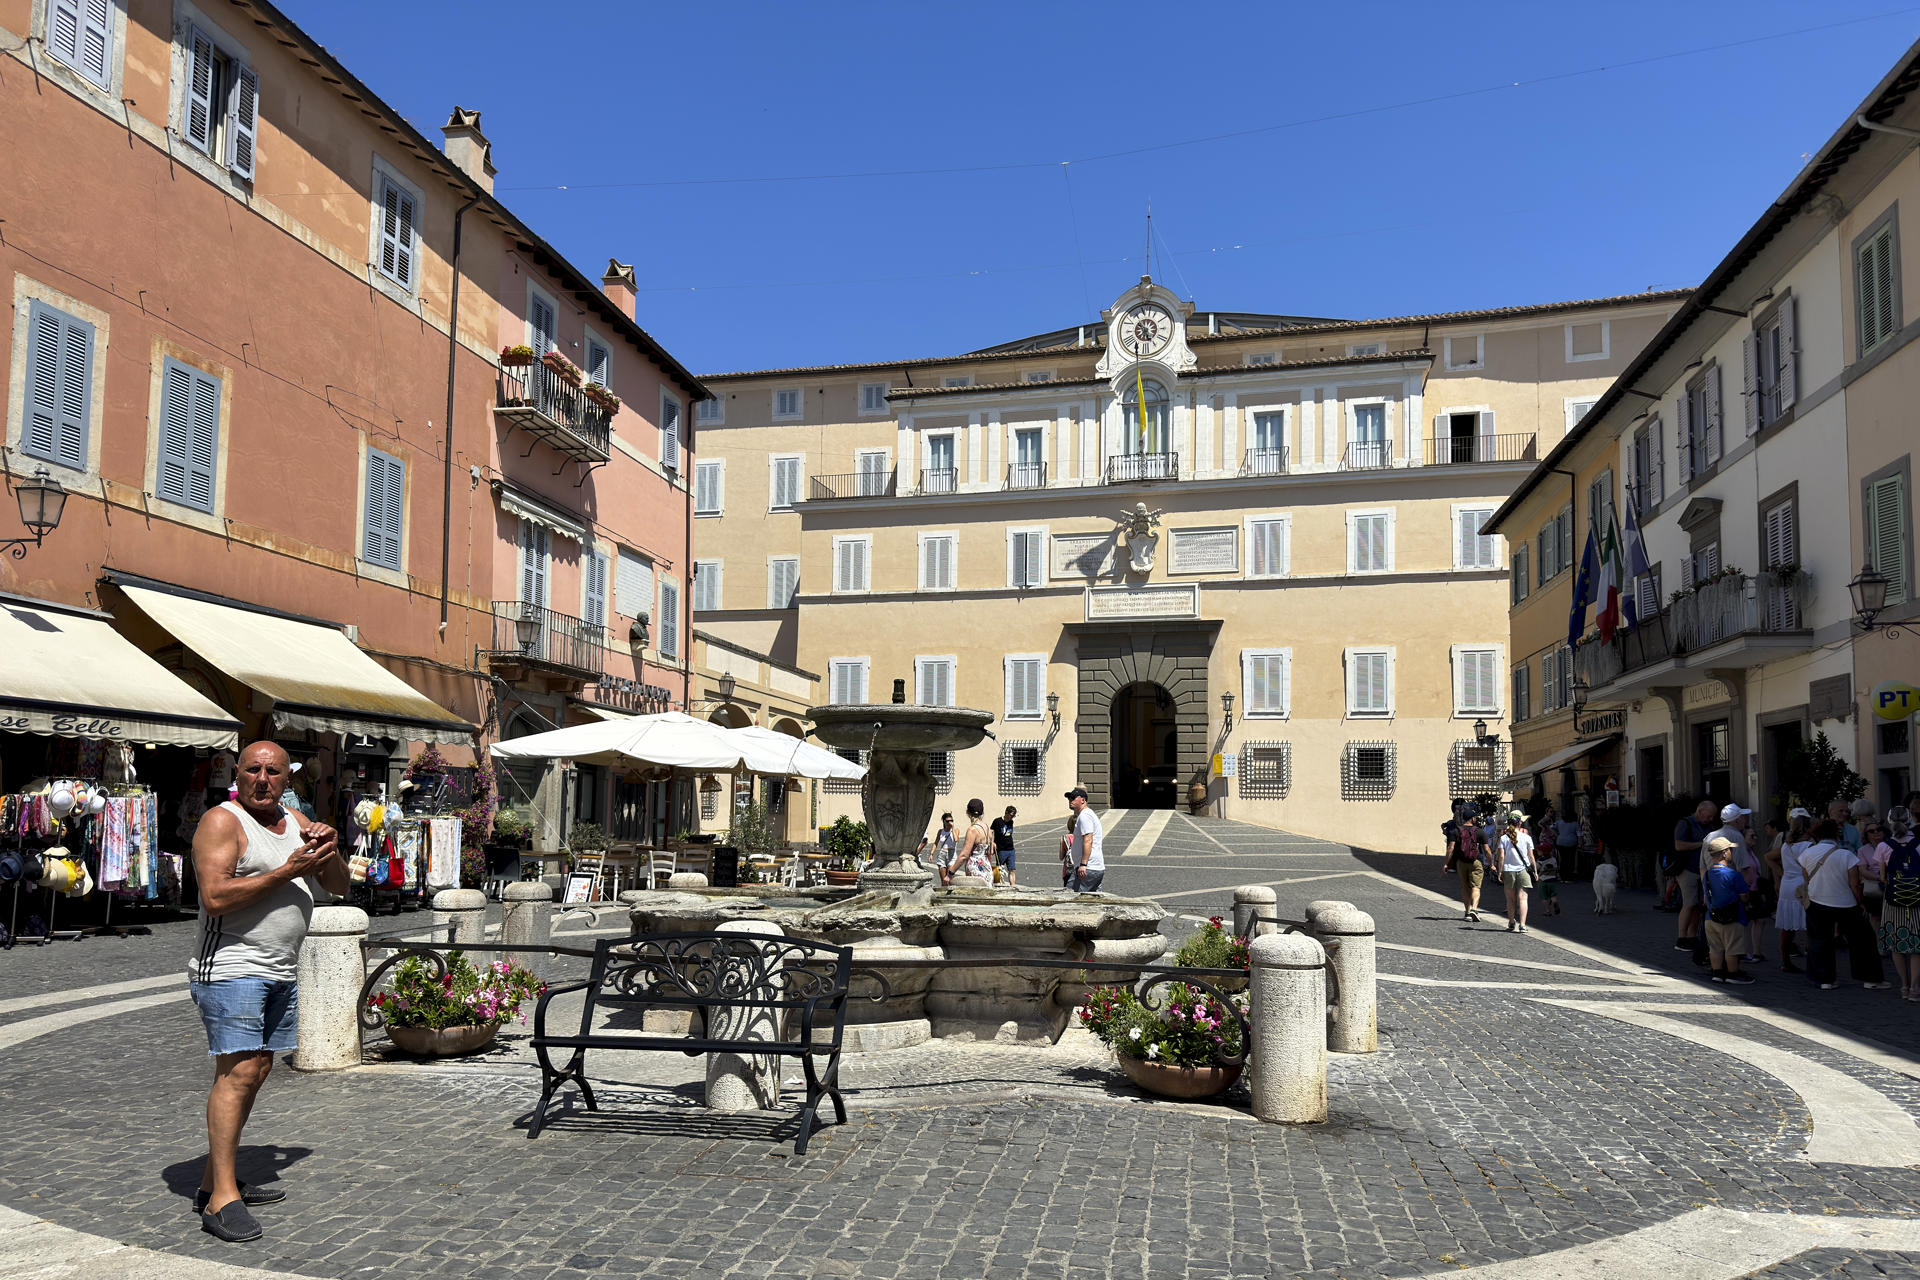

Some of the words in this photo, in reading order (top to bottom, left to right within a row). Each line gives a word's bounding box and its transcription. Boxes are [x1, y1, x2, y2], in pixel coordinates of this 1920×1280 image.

[598, 674, 672, 702] ARTIGIANATO
[1879, 690, 1911, 708] PT
[51, 714, 122, 736] Belle
[1580, 711, 1623, 735] SOUVENIRS
